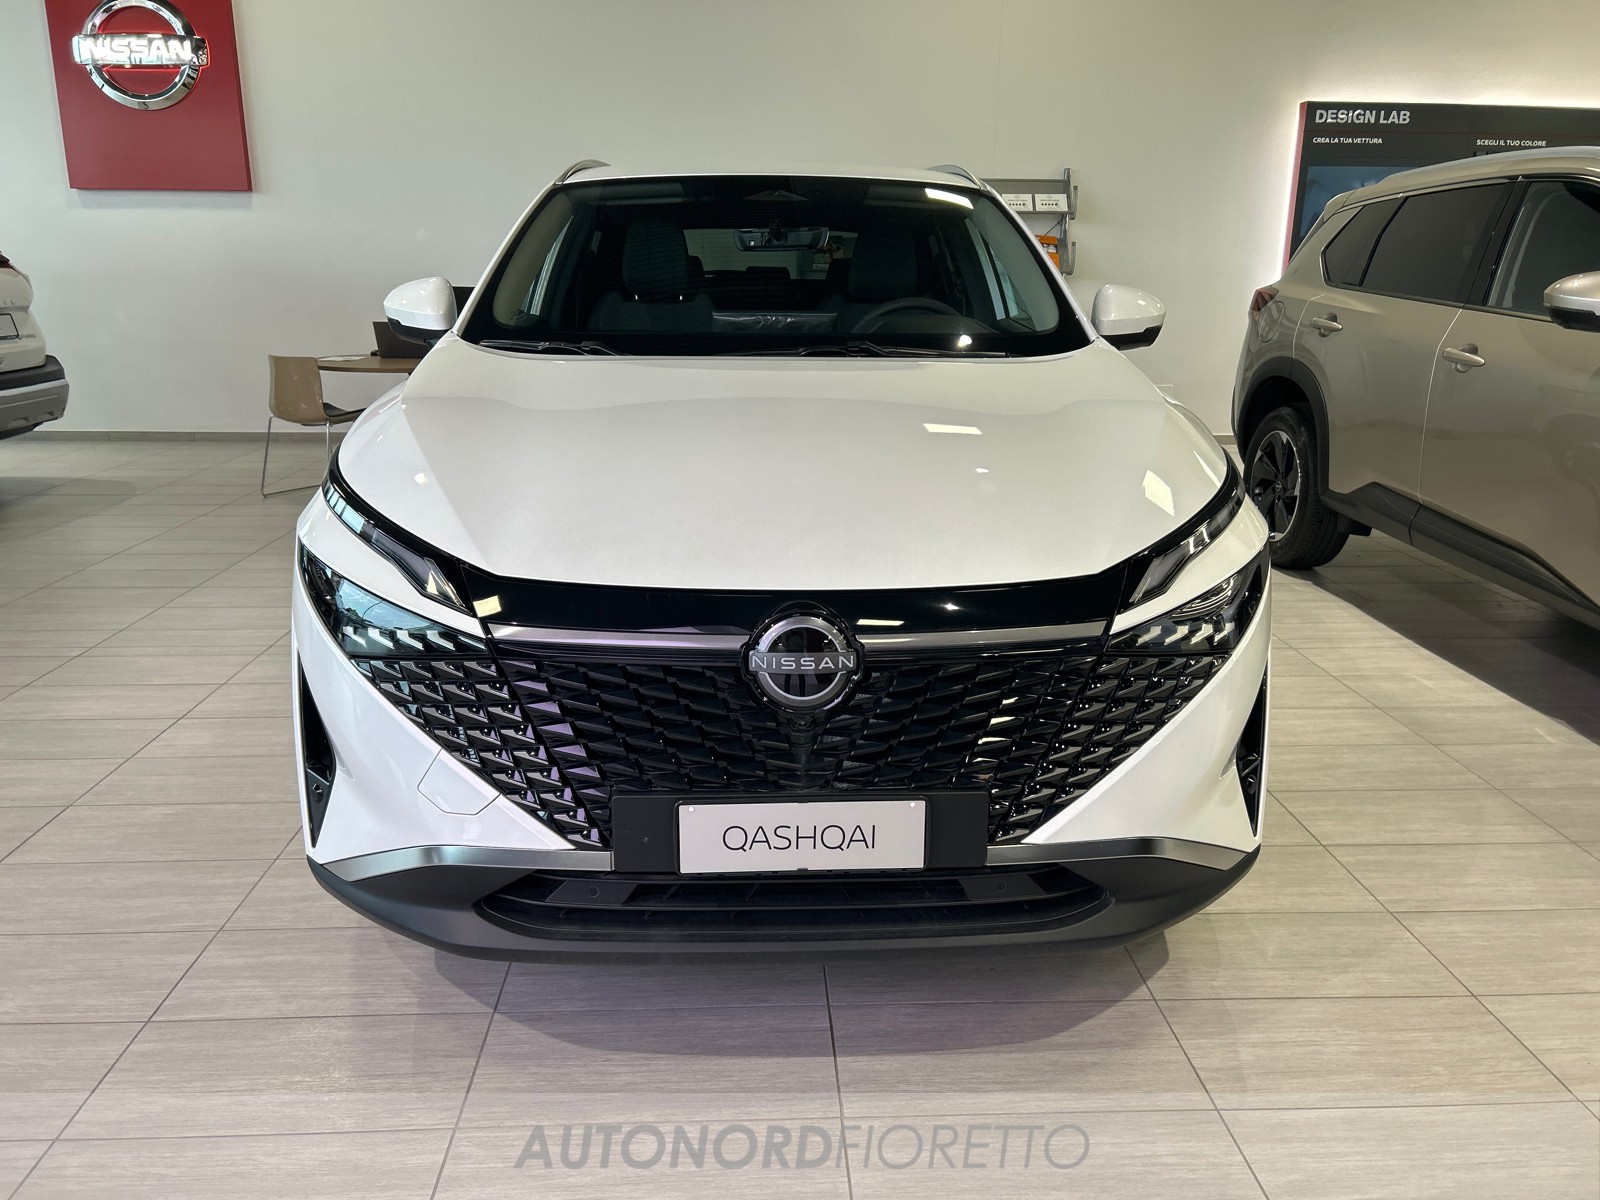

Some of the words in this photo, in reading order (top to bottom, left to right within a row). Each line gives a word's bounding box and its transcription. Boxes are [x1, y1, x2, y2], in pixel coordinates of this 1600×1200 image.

[81, 38, 192, 61] NISSAN
[1379, 110, 1411, 124] LAB
[1506, 139, 1520, 147] TUO
[751, 655, 855, 670] NISSAN
[722, 824, 876, 852] QASHQAI
